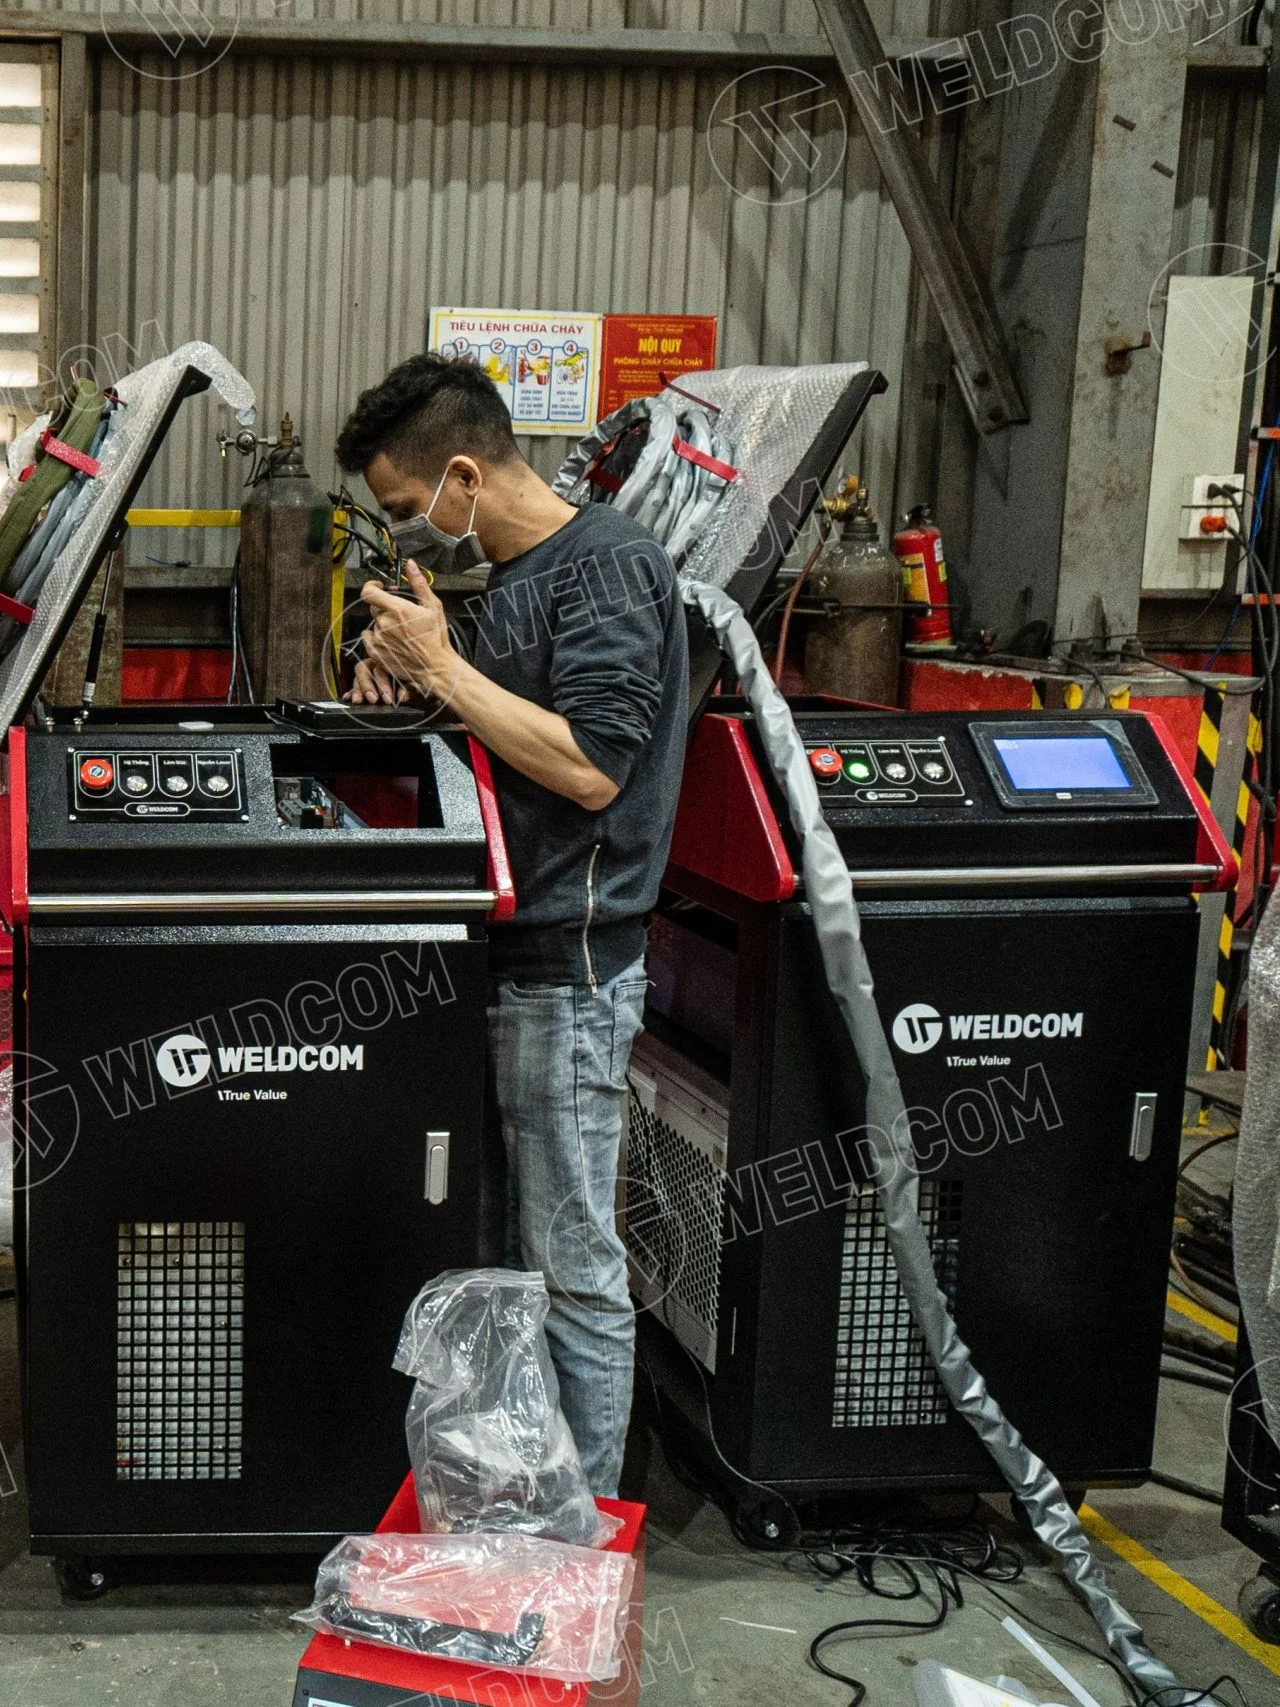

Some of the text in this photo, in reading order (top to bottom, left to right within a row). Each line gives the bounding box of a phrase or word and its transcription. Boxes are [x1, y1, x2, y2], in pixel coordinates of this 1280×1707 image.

[494, 341, 502, 350] 2
[530, 343, 538, 351] 3
[566, 344, 574, 352] 4
[949, 1012, 1084, 1040] WELDCOM
[218, 1045, 364, 1072] WELDCOM
[980, 1055, 1011, 1066] Value
[253, 1089, 287, 1100] Value
